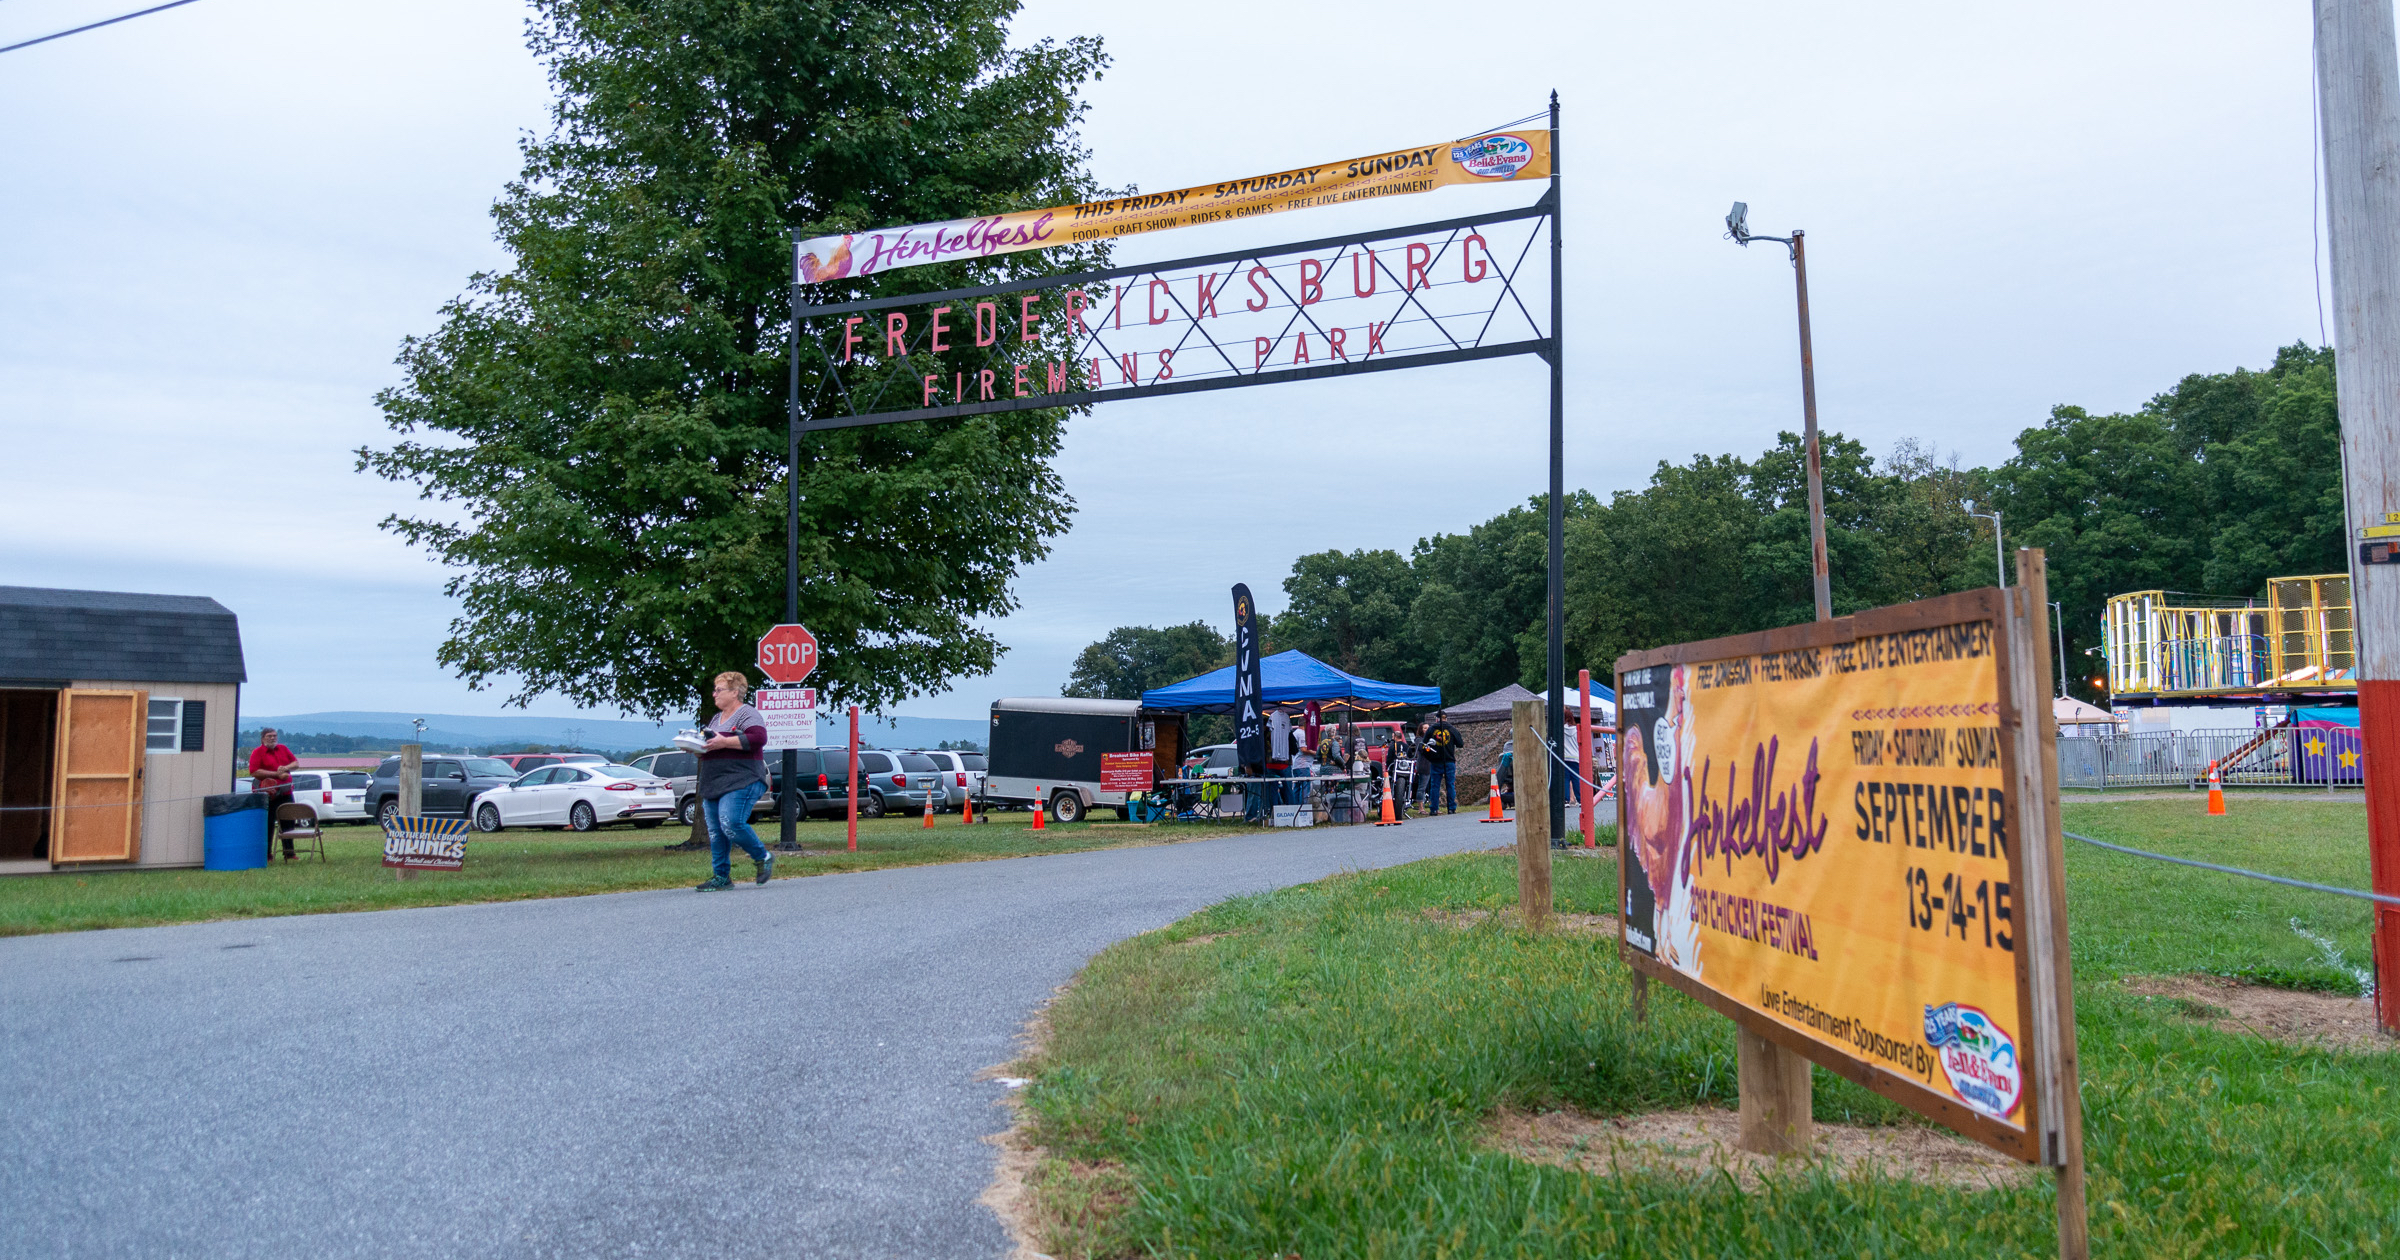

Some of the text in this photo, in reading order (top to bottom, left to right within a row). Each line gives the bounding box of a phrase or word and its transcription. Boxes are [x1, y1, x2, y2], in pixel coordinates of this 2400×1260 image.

[1074, 148, 1438, 220] THIS FRIDAY SATURDAY SUNDAY
[1468, 154, 1526, 168] Bell&Evans
[1072, 179, 1434, 242] FOOD CRAFT SHOW RIDES & GAMES FREE LIVE ENTERTAINMENT
[860, 212, 1054, 275] Hinkelfest
[845, 234, 1487, 362] FREDERICKSBURG
[924, 321, 1385, 407] FIREMANS PARK
[2363, 529, 2368, 537] 3
[762, 643, 814, 665] STOP
[1697, 664, 1713, 690] FREE
[1761, 653, 1782, 682] FREE
[1783, 648, 1822, 680] PARKING
[1829, 642, 1857, 675] FREE
[1858, 635, 1884, 671] LIVE
[762, 699, 810, 709] PROPERTY
[766, 690, 806, 700] PRIVATE
[1239, 724, 1260, 739] 22-5
[1851, 727, 2001, 768] FRIDAY SATURDAY SUNDA
[389, 830, 469, 842] NORTHERN LEBANON
[1681, 734, 1828, 889] Hinkelfest
[1855, 781, 2008, 861] SEPTEMBER
[384, 838, 464, 859] VIKINGS
[1690, 884, 1818, 961] 2019 CHICKEN FESTIVAL
[1906, 866, 2013, 951] 13-14-15
[1761, 983, 1780, 1013] Live
[1782, 990, 1852, 1043] Entertainment
[1916, 1045, 1934, 1084] By
